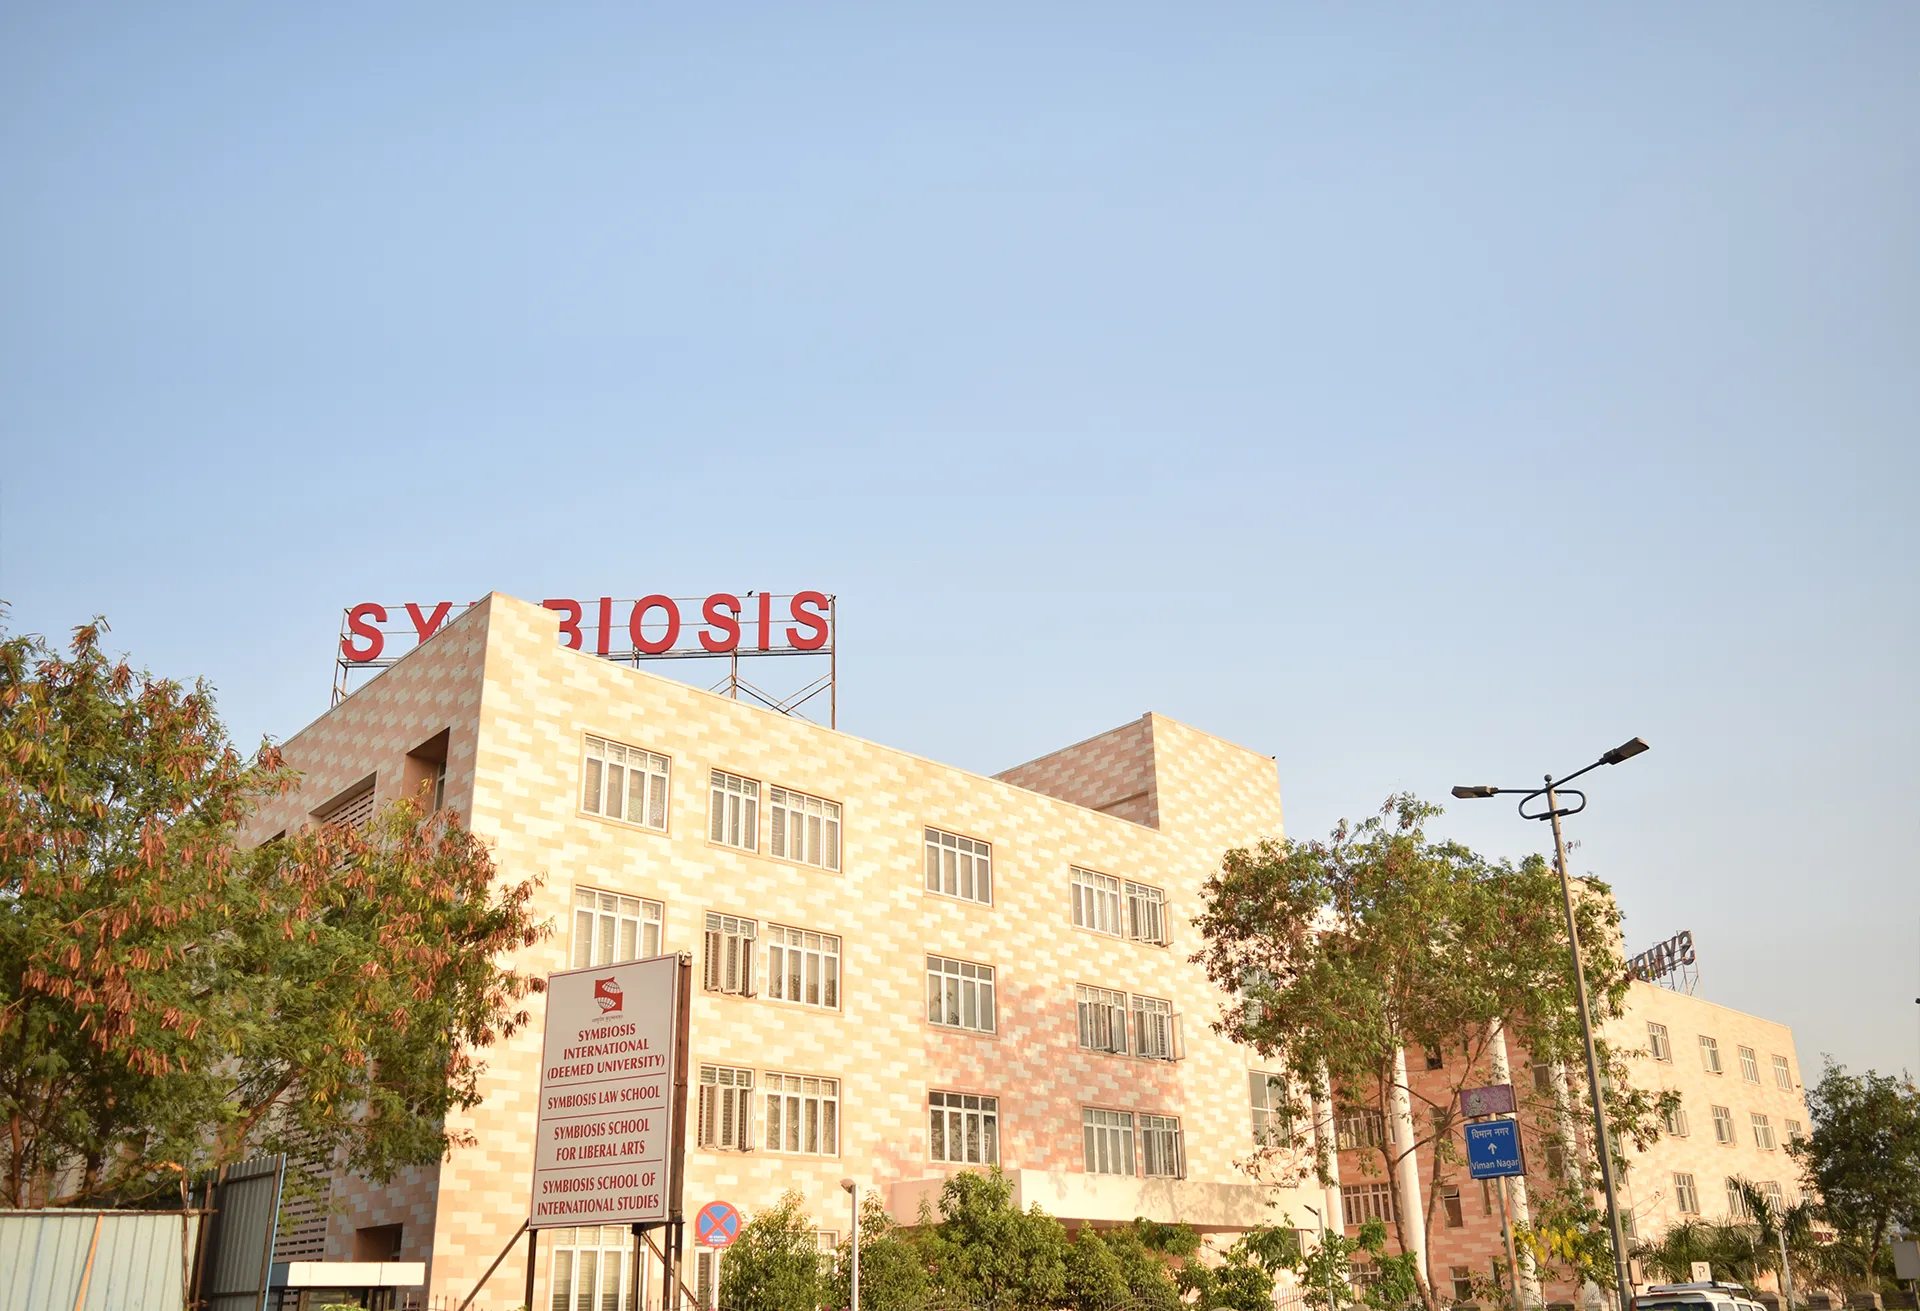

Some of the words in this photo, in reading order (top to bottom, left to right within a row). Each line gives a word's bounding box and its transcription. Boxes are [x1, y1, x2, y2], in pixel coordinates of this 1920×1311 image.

[341, 590, 829, 662] SYBIOSIS
[578, 1023, 636, 1042] SYMBIOSIS
[563, 1038, 649, 1060] INTERNATIONAL
[547, 1063, 594, 1080] (DEEMED
[597, 1054, 665, 1074] UNIVERSITY)
[548, 1092, 597, 1110] SYMBIOSIS
[599, 1090, 618, 1104] LAW
[620, 1085, 660, 1102] SCHOOL
[554, 1122, 606, 1140] SYMBIOSIS
[608, 1118, 650, 1135] SCHOOL
[1472, 1129, 1492, 1139] विमान
[1495, 1128, 1509, 1136] नगर
[556, 1146, 576, 1161] FOR
[578, 1142, 618, 1160] LIBERAL
[620, 1140, 645, 1156] ARTS
[1471, 1161, 1494, 1170] Viman
[1497, 1160, 1518, 1168] Nagar
[542, 1177, 595, 1194] SYMBIOSIS
[597, 1173, 639, 1190] SCHOOL
[641, 1172, 656, 1187] OF
[537, 1197, 614, 1216] INTERNATIONAL
[617, 1193, 659, 1211] STUDIES
